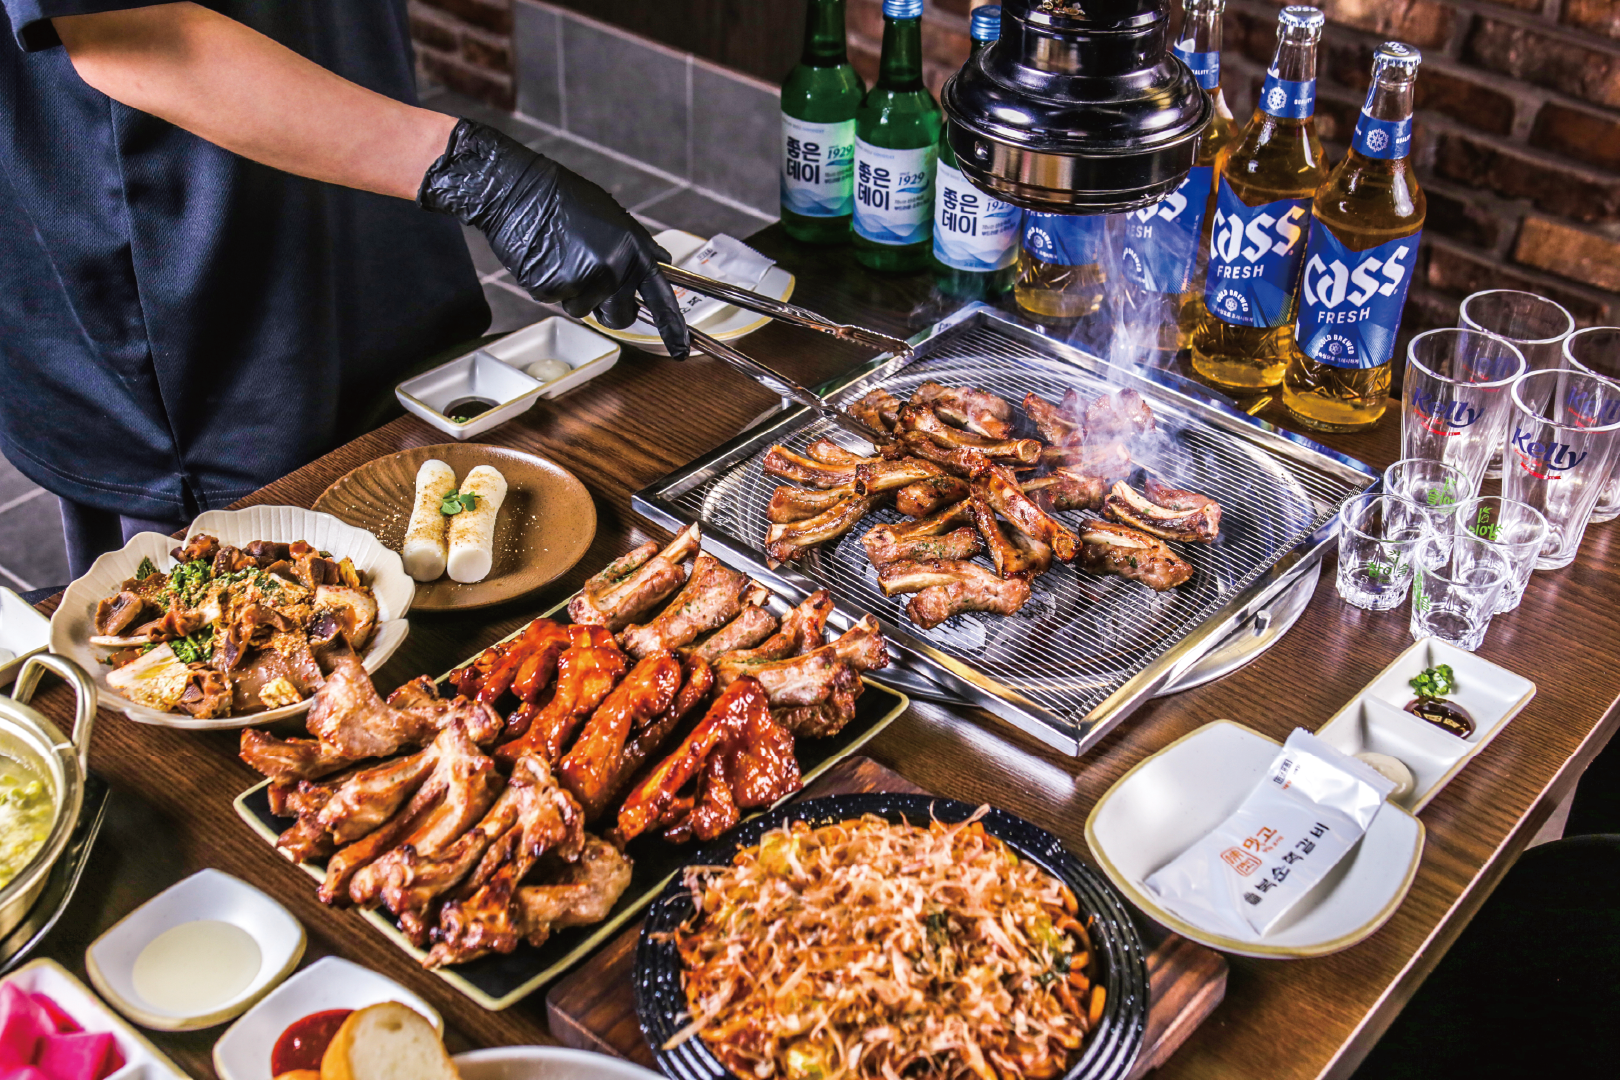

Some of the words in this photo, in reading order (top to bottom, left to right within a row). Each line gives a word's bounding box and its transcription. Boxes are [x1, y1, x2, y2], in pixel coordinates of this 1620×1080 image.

[786, 135, 821, 163] 좋은
[827, 144, 853, 160] 1929
[786, 158, 820, 185] 데이
[858, 160, 891, 189] 좋은
[898, 172, 925, 187] 1929
[858, 181, 890, 211] 데이
[943, 186, 979, 215] 좋은
[942, 209, 978, 237] 데이
[1217, 264, 1265, 279] FRESH
[1303, 245, 1410, 309] Cass
[1229, 289, 1249, 312] BREWED
[1317, 306, 1371, 324] FRESH
[1333, 334, 1355, 355] BREWED
[1411, 387, 1485, 428] Kelly
[1511, 426, 1588, 471] Kelly
